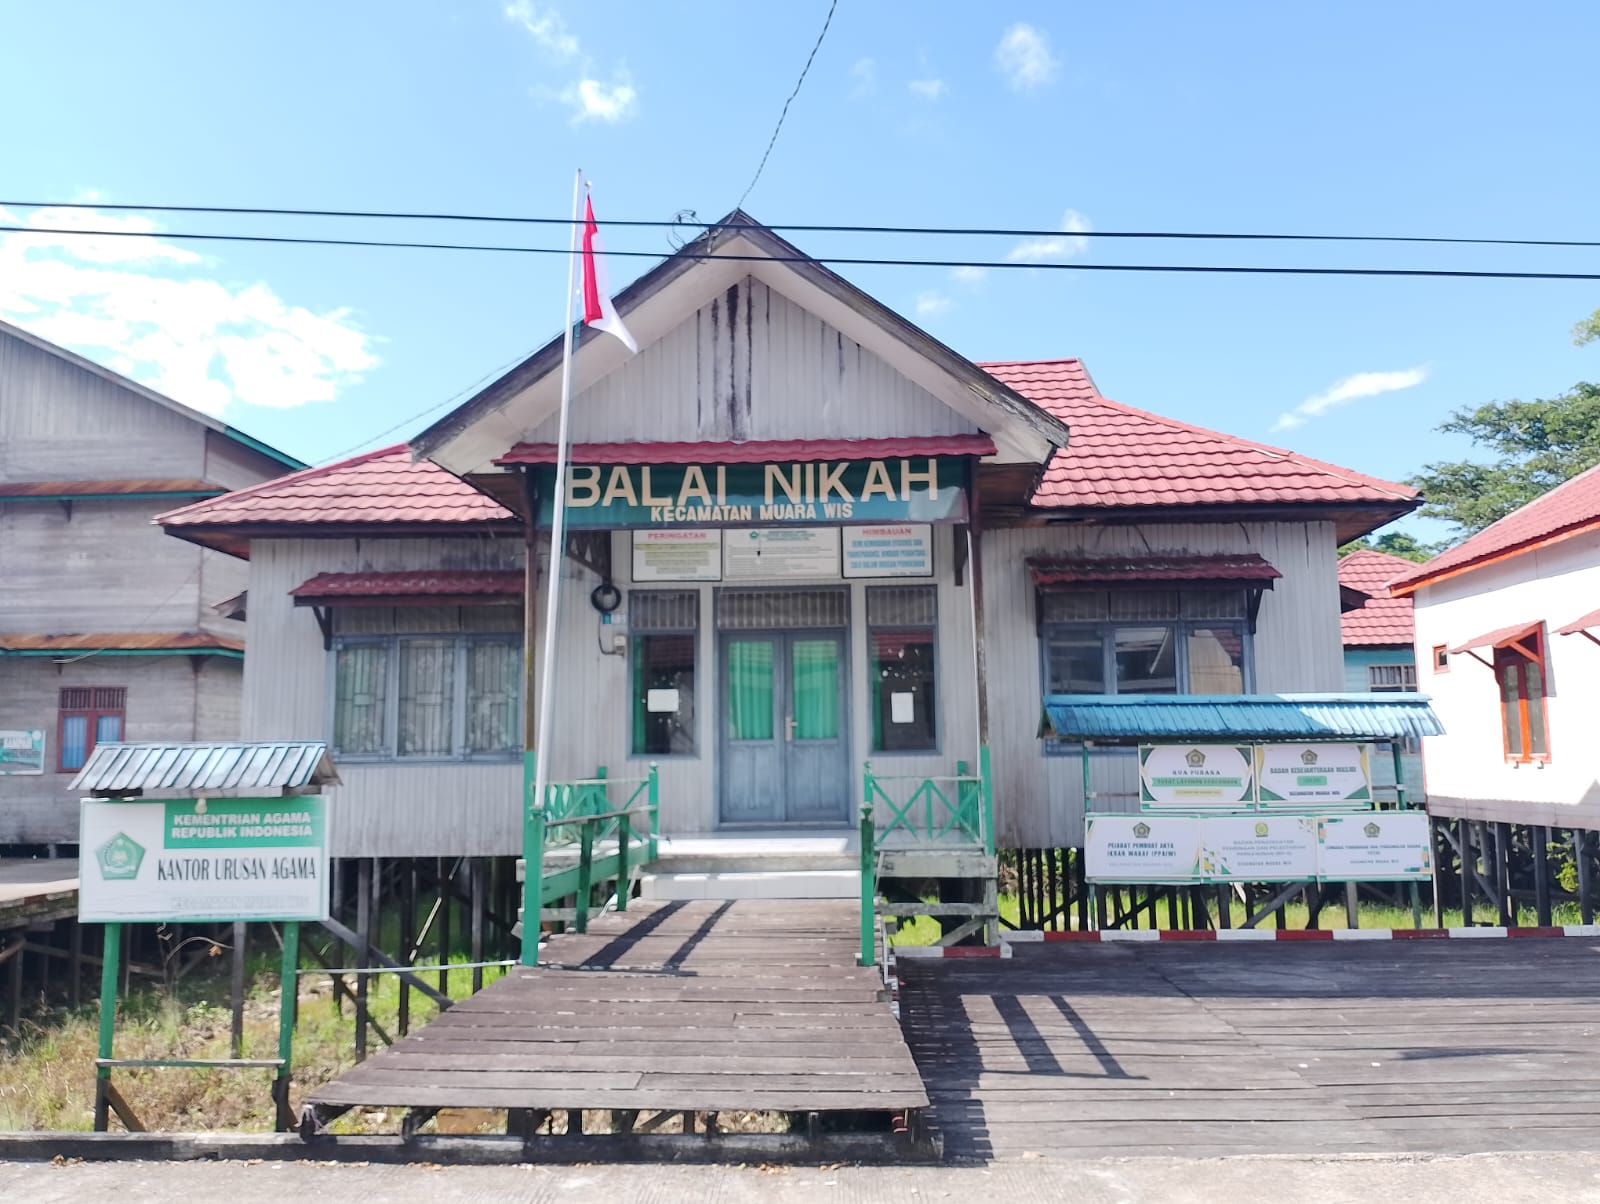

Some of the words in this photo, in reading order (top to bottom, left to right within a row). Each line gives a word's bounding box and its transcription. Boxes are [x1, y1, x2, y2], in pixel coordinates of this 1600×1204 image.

[565, 464, 726, 508] BALAI
[764, 458, 938, 505] NIKAH
[650, 504, 752, 523] KECAMATAN
[759, 503, 817, 520] MUARA
[824, 502, 854, 519] WIS
[173, 814, 261, 826] KEMENTRIAN
[263, 812, 312, 825] AGAMA
[171, 826, 238, 839] REPUBLIK
[240, 825, 313, 838] INDONESIA
[157, 858, 210, 881] KANTOR
[215, 858, 268, 881] URUSAN
[271, 857, 317, 880] AGAMA
